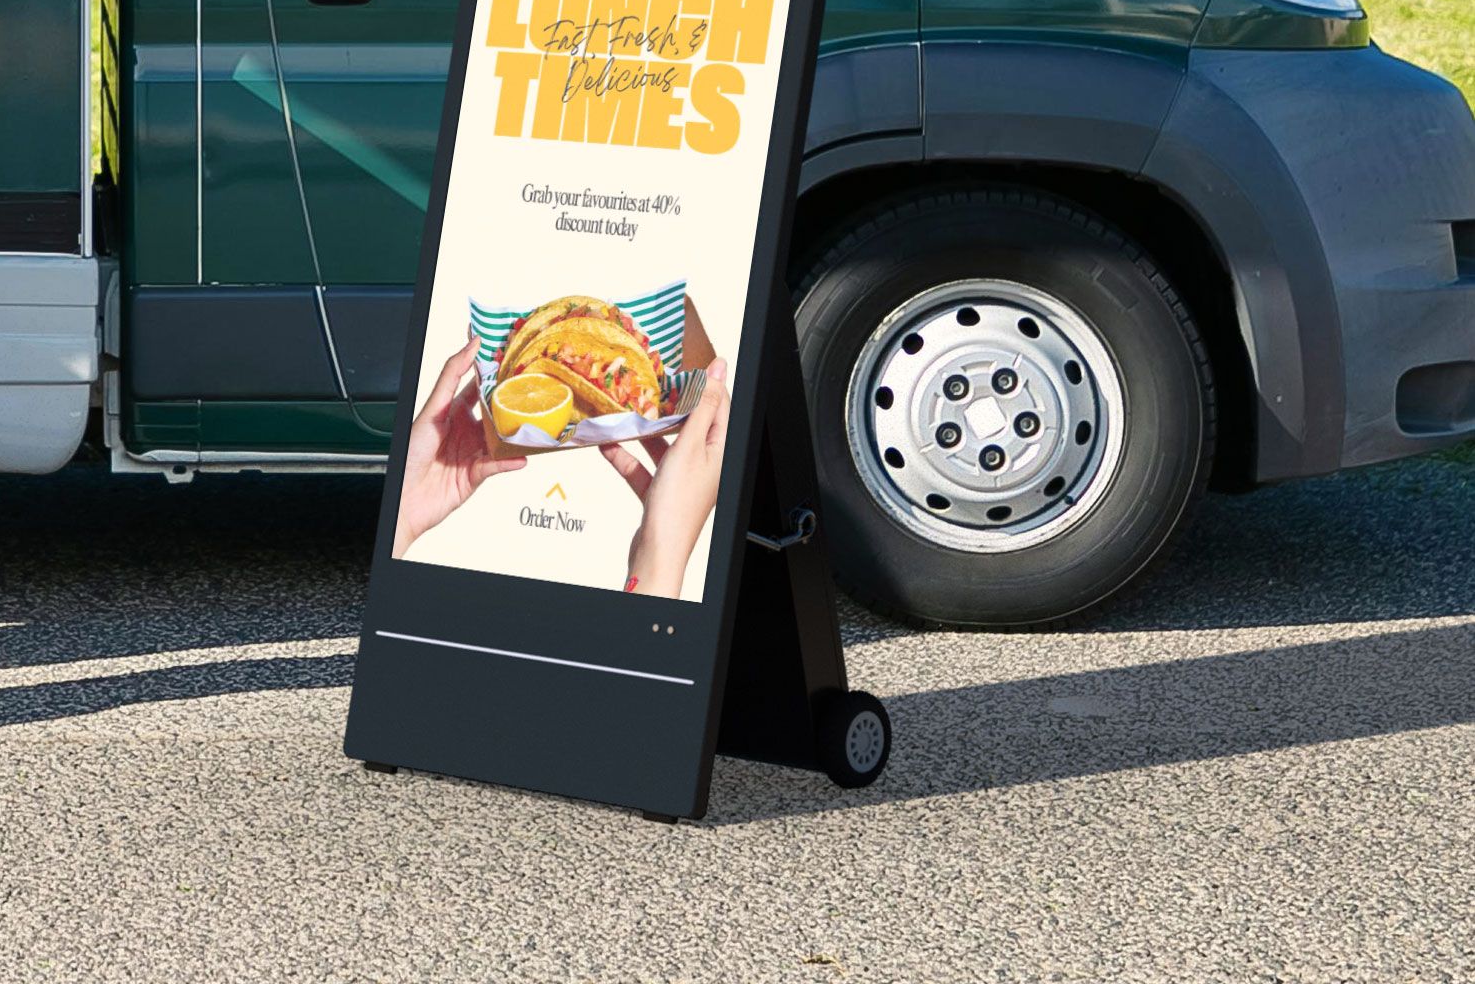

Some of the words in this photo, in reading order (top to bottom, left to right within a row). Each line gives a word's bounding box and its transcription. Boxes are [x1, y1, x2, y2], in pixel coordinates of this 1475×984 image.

[561, 56, 679, 104] Delicious
[493, 50, 746, 155] TIMES
[521, 183, 553, 205] Grab
[551, 191, 582, 210] your
[581, 187, 638, 212] favourites
[637, 196, 651, 213] at
[651, 193, 681, 216] 40%
[555, 211, 604, 235] discount
[605, 216, 639, 242] today
[519, 506, 555, 529] Order
[555, 510, 587, 533] Now
